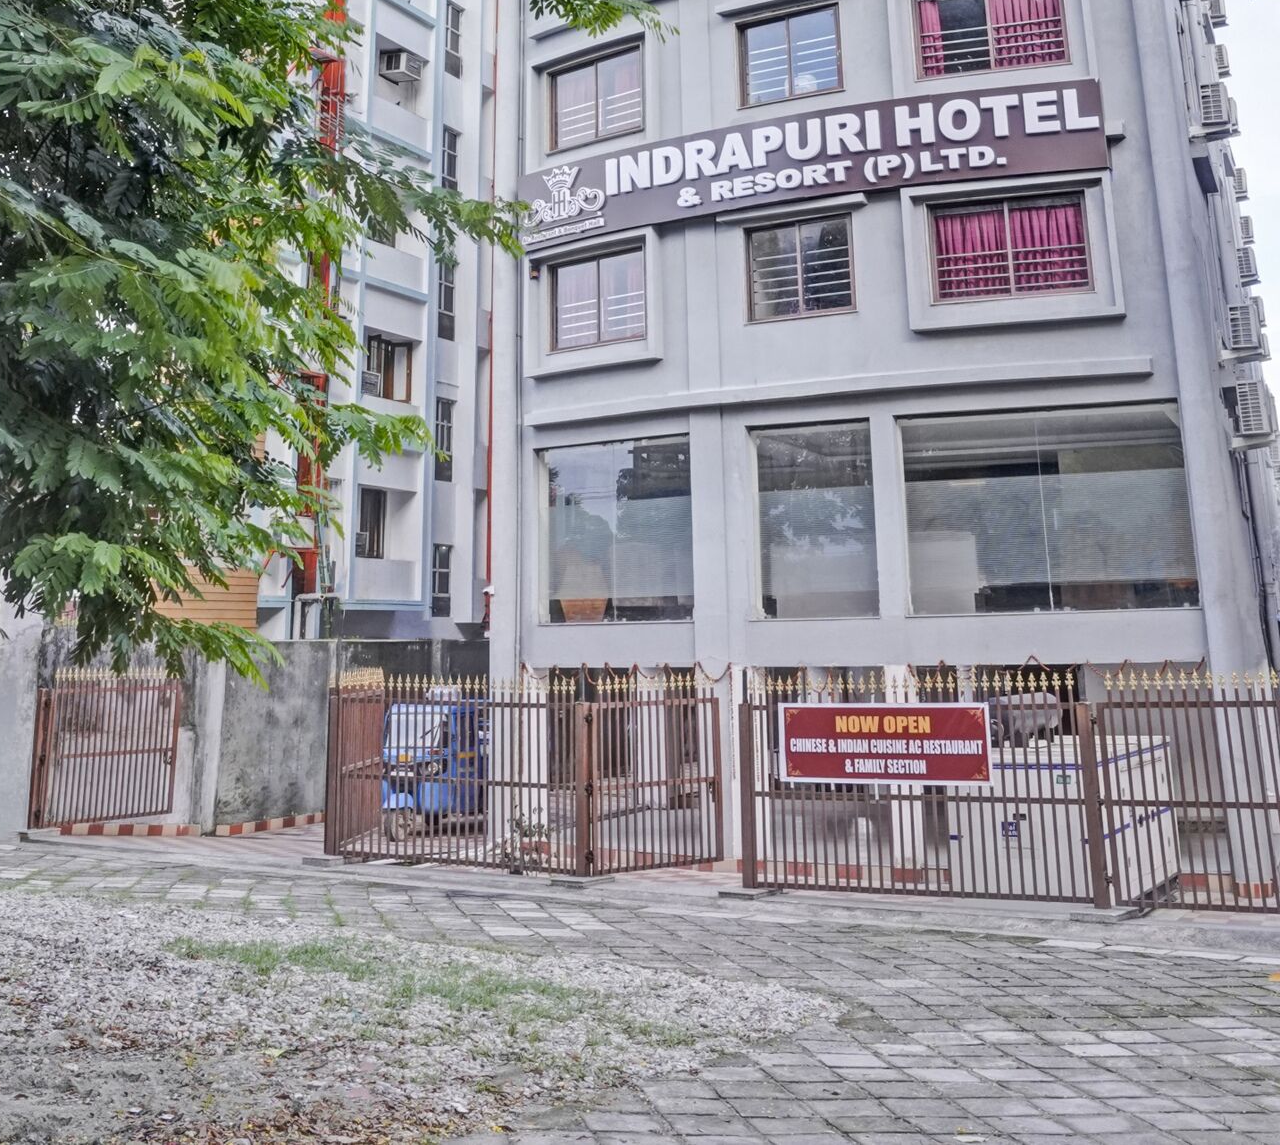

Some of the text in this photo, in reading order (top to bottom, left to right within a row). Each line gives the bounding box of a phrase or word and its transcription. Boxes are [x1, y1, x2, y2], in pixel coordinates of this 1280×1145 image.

[605, 89, 1100, 196] INDRAPURI HOTEL
[676, 187, 703, 207] &
[710, 160, 852, 202] RESORT
[835, 715, 931, 734] NOW OPEN
[790, 738, 983, 755] CHINESE & INDIAN CUISINE AC RESTAURANT
[845, 759, 927, 774] & FAMILY SECTION
